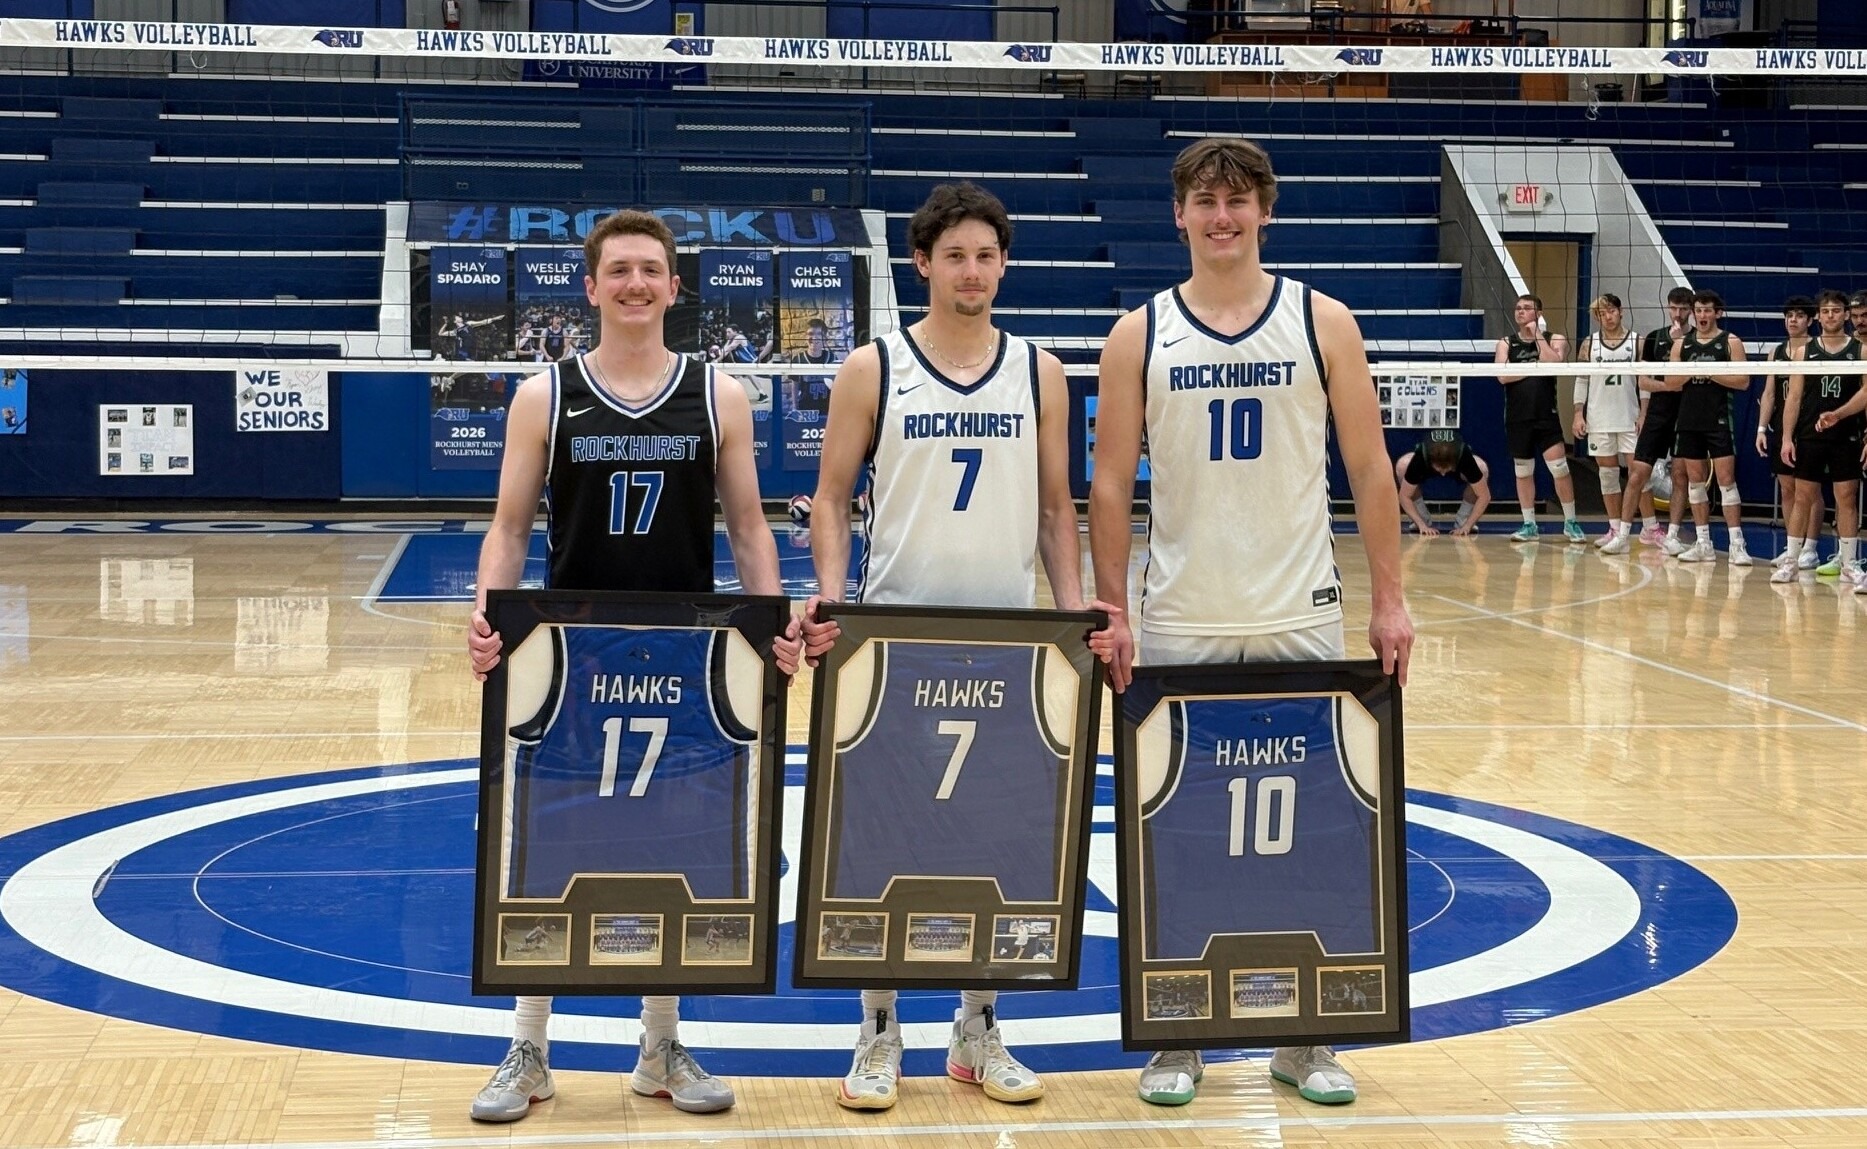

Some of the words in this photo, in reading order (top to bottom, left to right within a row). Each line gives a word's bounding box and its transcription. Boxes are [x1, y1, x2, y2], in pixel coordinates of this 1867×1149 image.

[55, 21, 125, 43] HAWKS
[133, 23, 257, 46] VOLLEYBALL
[417, 31, 484, 52] HAWKS
[494, 32, 612, 55] VOLLEYBALL
[765, 38, 829, 59] HAWKS
[838, 40, 952, 62] VOLLEYBALL
[1101, 45, 1164, 65] HAWKS
[1172, 46, 1285, 66] VOLLEYBALL
[1431, 47, 1494, 67] HAWKS
[1501, 48, 1612, 69] VOLLEYBALL
[1756, 50, 1817, 69] HAWKS
[1824, 51, 1867, 69] VOLL
[1515, 186, 1539, 204] EXIT
[451, 261, 487, 272] SHAY
[526, 263, 579, 273] WESLEY
[719, 265, 754, 275] RYAN
[795, 266, 837, 276] CHASE
[437, 274, 501, 284] SPADARO
[535, 274, 570, 285] YUSK
[710, 276, 763, 287] COLLINS
[791, 278, 841, 288] WILSON
[245, 370, 280, 386] WE
[1169, 361, 1296, 391] ROCKHURST
[1821, 375, 1841, 398] 14
[255, 392, 303, 407] OUR
[1397, 386, 1437, 396] COLLINS
[238, 411, 324, 430] SENIORS
[904, 412, 1024, 440] ROCKHURST
[1208, 397, 1262, 461] 10
[451, 427, 486, 438] 2026
[802, 429, 826, 439] 202
[571, 435, 701, 463] ROCKHURST
[951, 448, 983, 511] 7
[609, 471, 664, 535] 17
[590, 674, 682, 704] HAWKS
[914, 679, 1005, 708] HAWKS
[598, 716, 669, 797] 17
[935, 720, 977, 800] 7
[1215, 735, 1306, 766] HAWKS
[1228, 775, 1296, 856] 10
